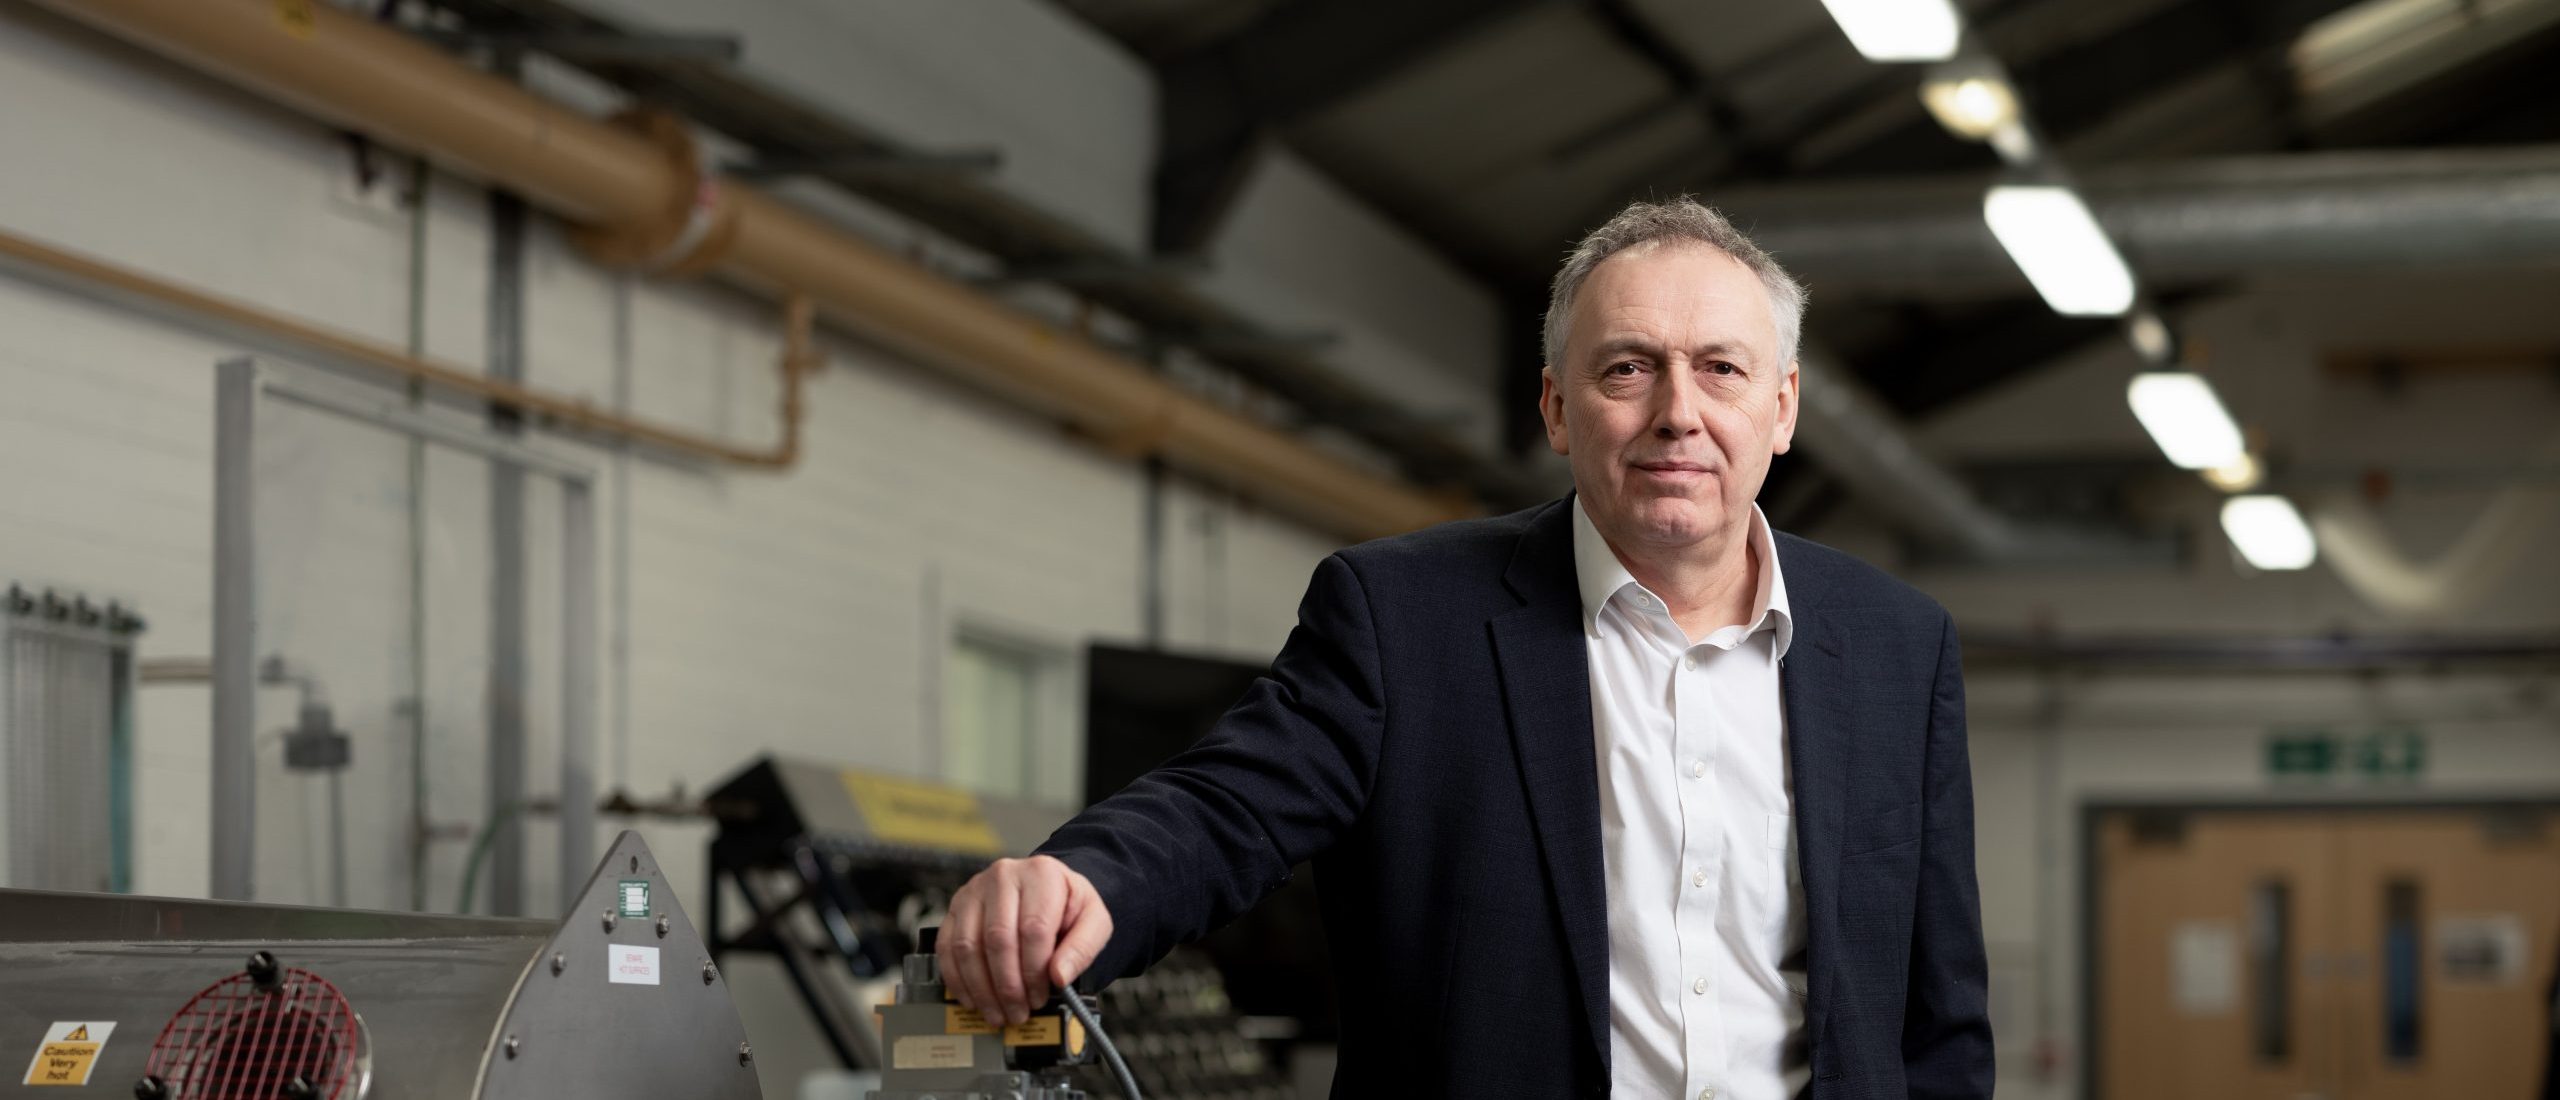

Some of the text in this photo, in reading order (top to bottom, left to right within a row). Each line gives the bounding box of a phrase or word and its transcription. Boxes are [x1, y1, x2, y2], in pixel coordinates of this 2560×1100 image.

[44, 1046, 95, 1056] Caution
[50, 1058, 78, 1069] Very
[46, 1070, 69, 1080] hot
